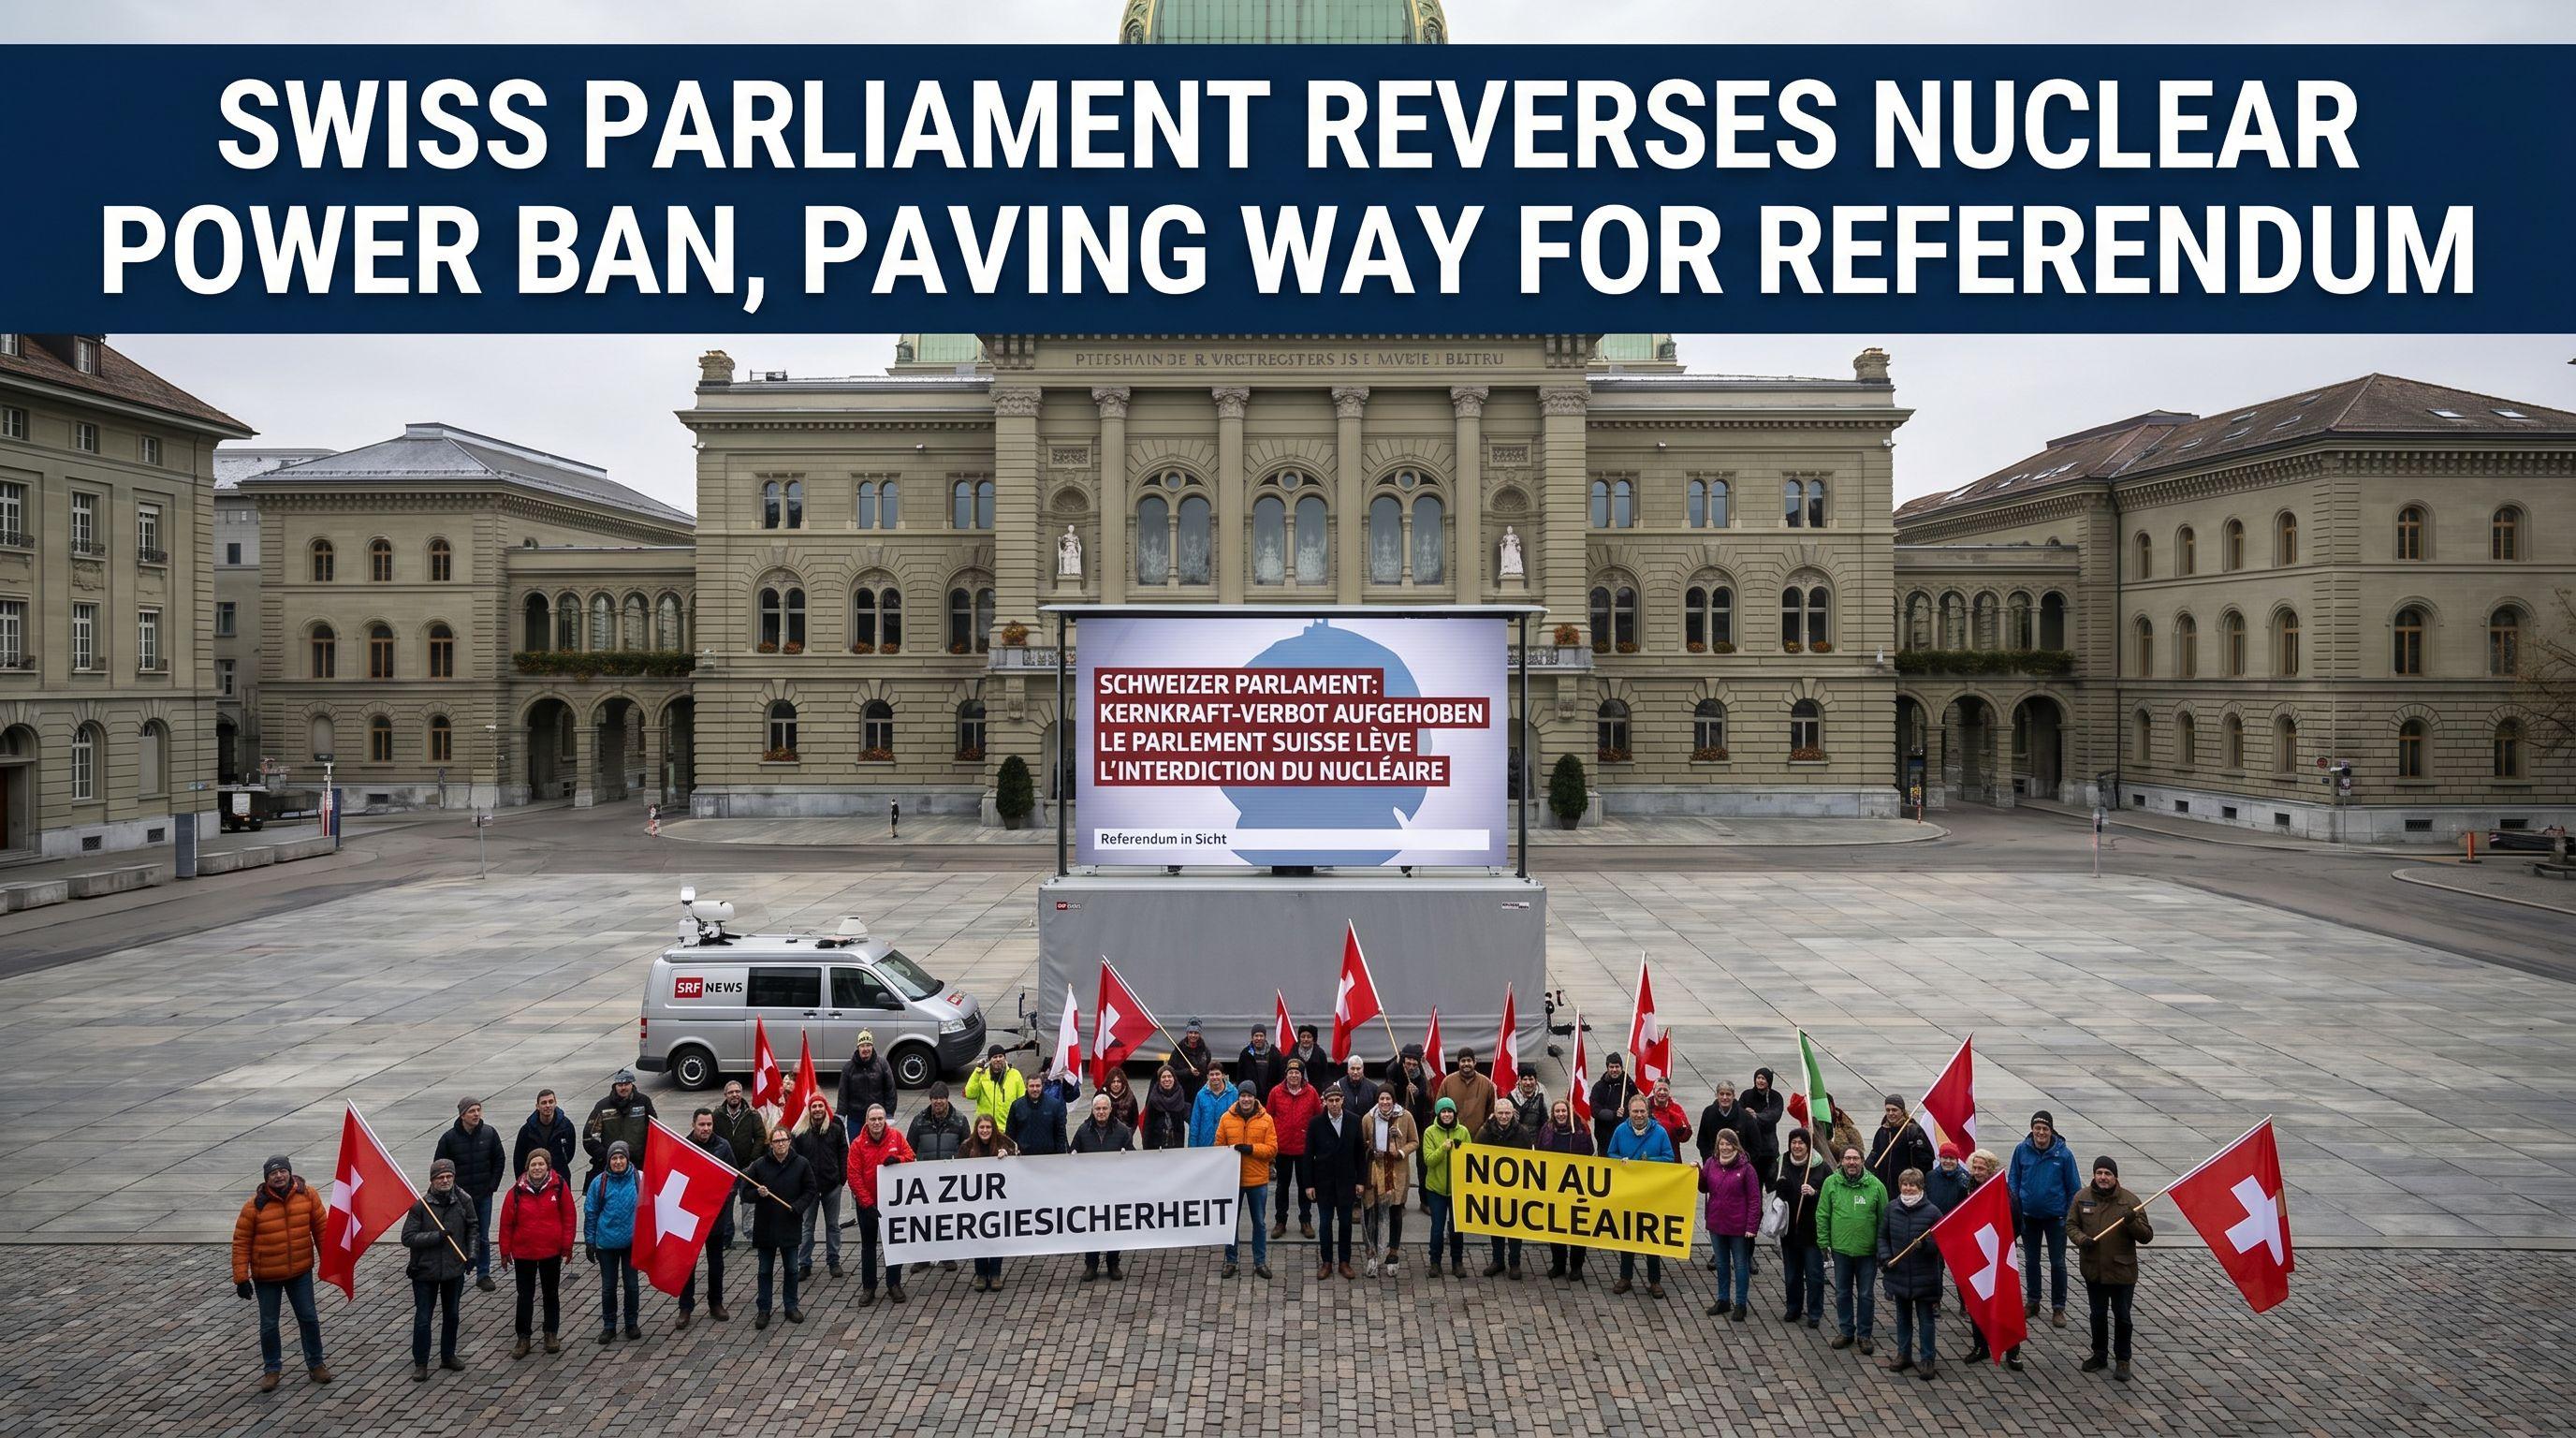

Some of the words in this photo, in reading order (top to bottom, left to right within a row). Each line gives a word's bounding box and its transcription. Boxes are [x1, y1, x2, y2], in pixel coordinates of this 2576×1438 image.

[1100, 674, 1229, 695] SCHWEIZER
[1235, 674, 1378, 695] PARLAMENT:
[1100, 703, 1328, 724] KERNKRAFT-VERBOT
[1333, 703, 1483, 724] AUFGEHOBEN
[1100, 732, 1126, 752] LE
[1133, 732, 1266, 752] PARLEMENT
[1272, 732, 1350, 752] SUISSE
[1356, 726, 1412, 752] LÈVE
[1281, 761, 1313, 781] DU
[1320, 756, 1443, 781] NUCLÉAIRE
[1101, 832, 1178, 844] Referendum
[1180, 832, 1193, 844] in
[1195, 832, 1227, 844] Sicht
[677, 982, 701, 993] SRF
[705, 982, 743, 993] NEWS
[1465, 1152, 1547, 1192] NON
[1557, 1164, 1612, 1198] AU
[888, 1178, 929, 1207] JA
[938, 1172, 1007, 1203] ZUR
[888, 1197, 1234, 1245] ENERGIESICHERHEIT
[1465, 1194, 1685, 1248] NUCLÉAIRE
